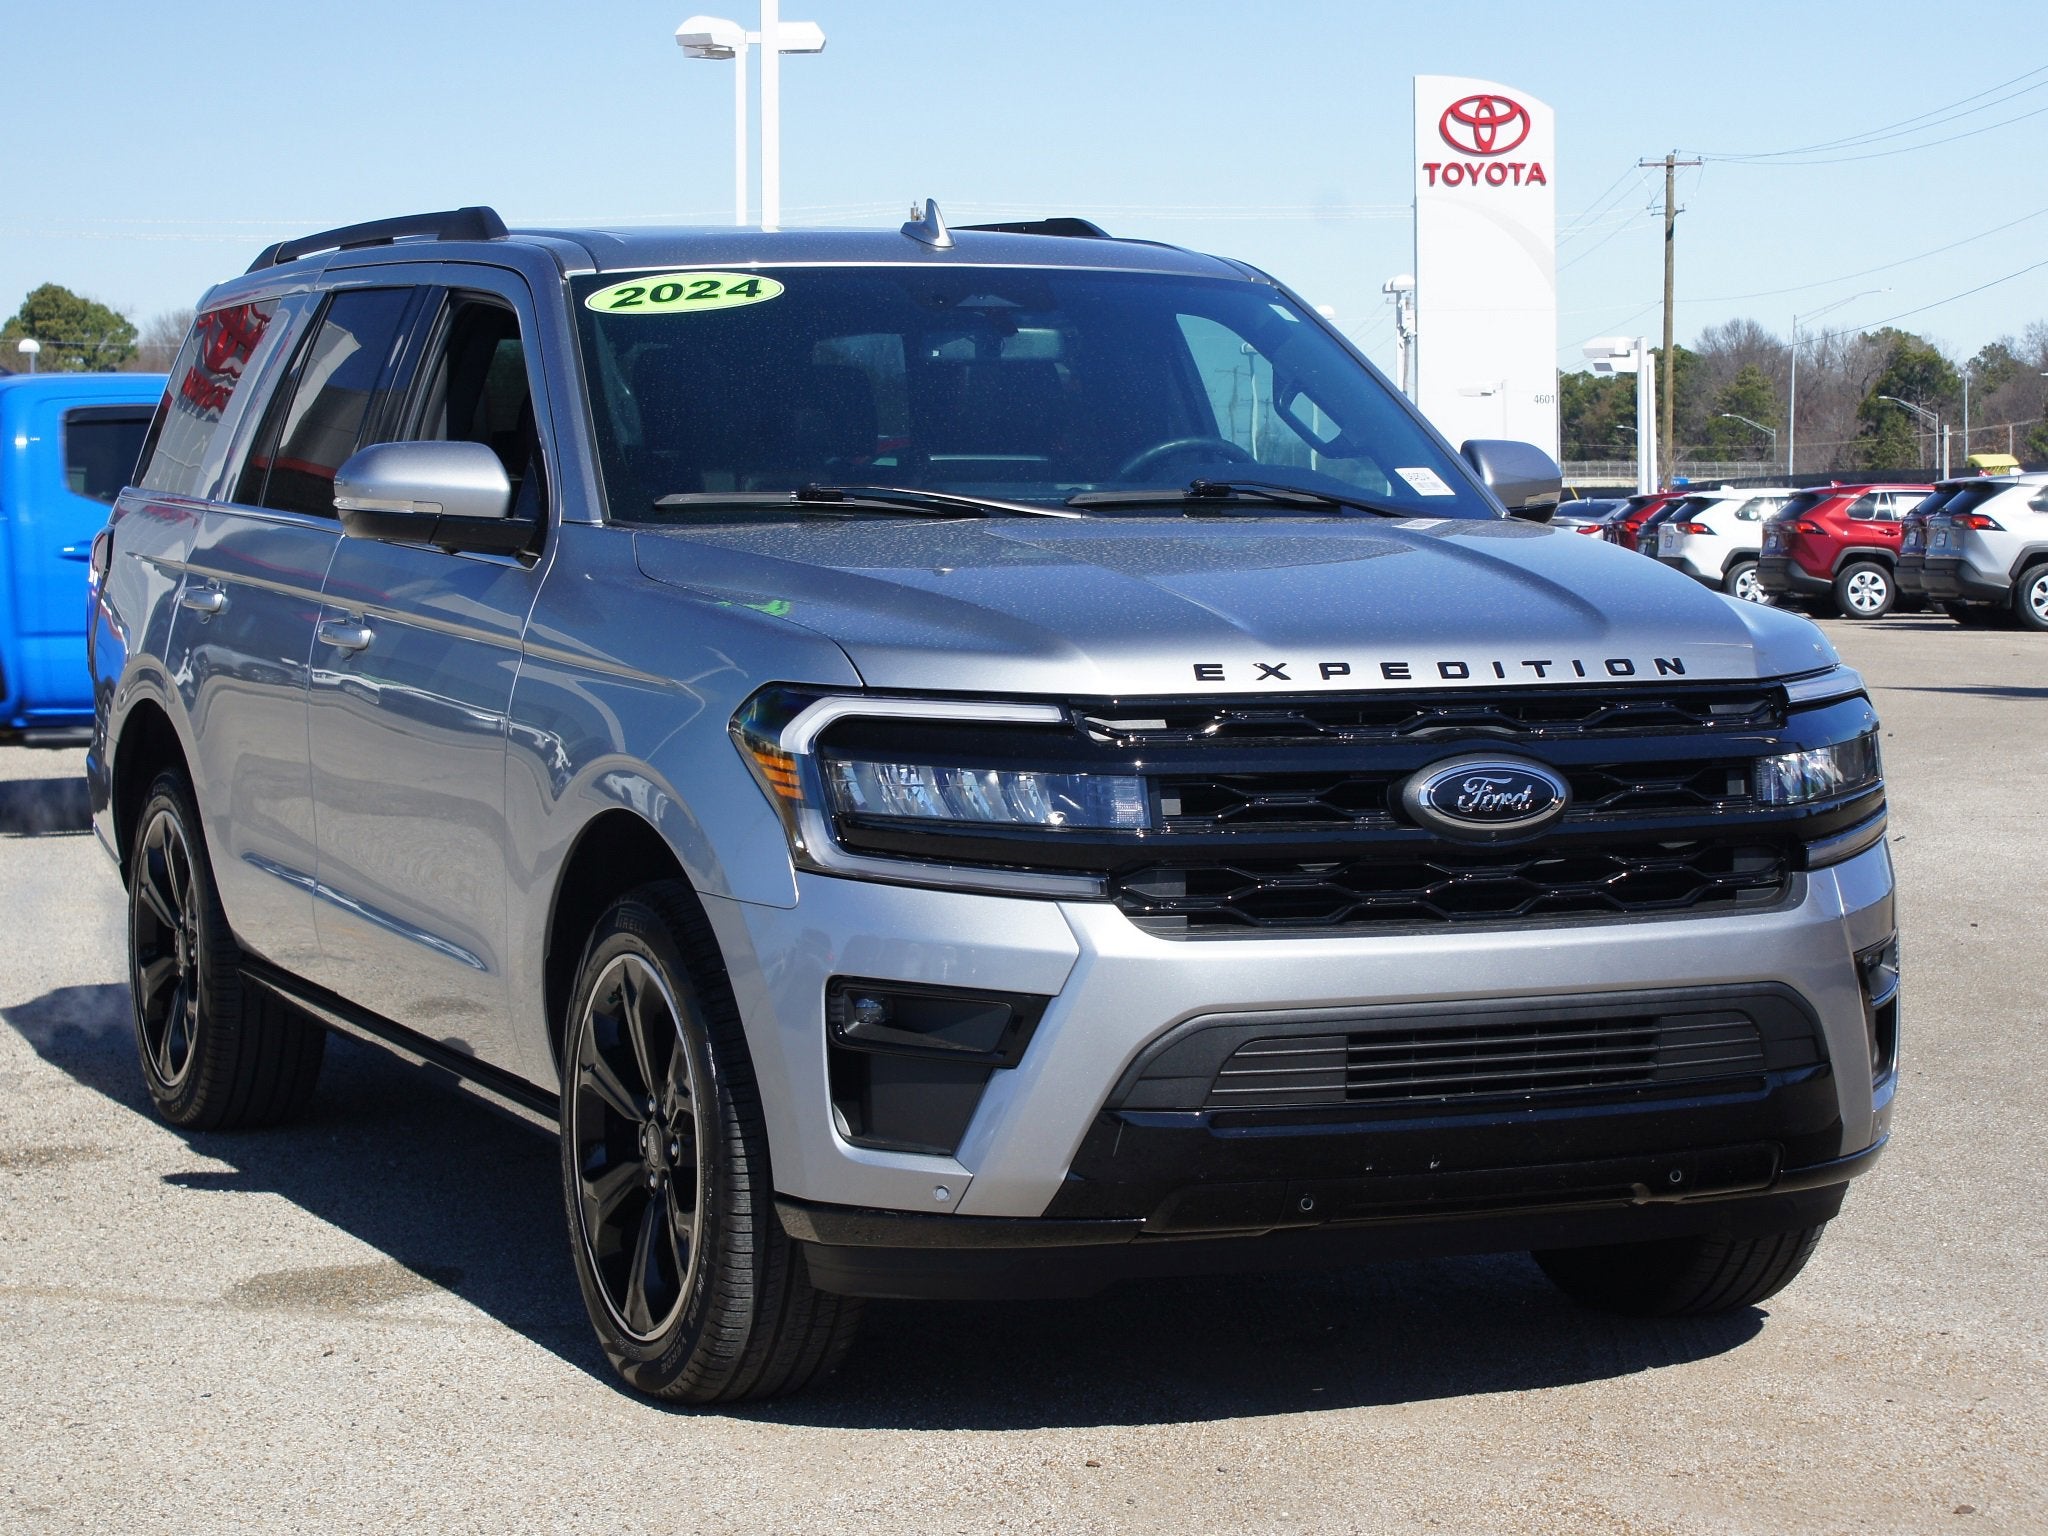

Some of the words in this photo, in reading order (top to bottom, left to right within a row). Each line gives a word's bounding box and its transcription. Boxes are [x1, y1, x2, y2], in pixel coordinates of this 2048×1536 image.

[1422, 162, 1547, 187] TOYOTA
[609, 279, 762, 309] 2024
[1534, 394, 1555, 404] 4601
[1193, 657, 1686, 681] EXPEDITION
[1457, 776, 1533, 812] Ford
